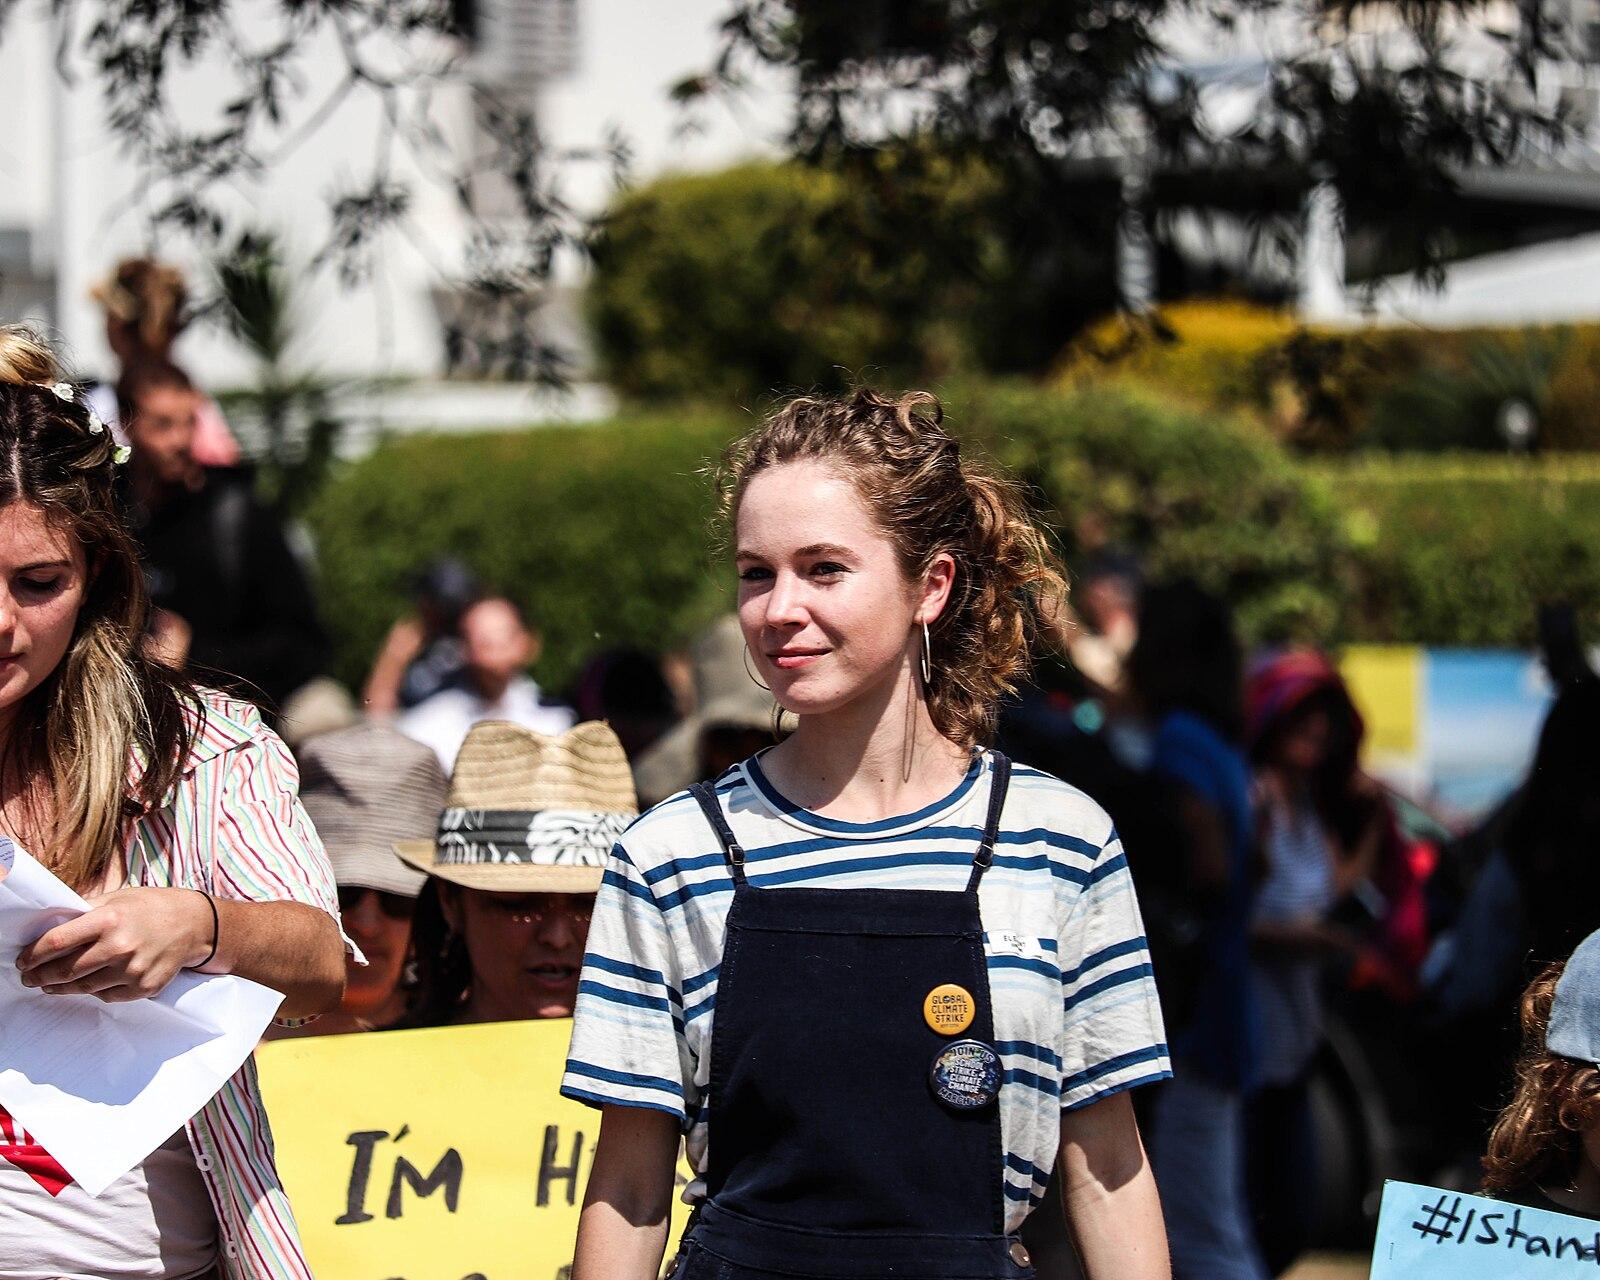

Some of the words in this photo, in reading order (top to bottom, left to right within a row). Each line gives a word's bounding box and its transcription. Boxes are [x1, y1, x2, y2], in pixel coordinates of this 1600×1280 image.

[932, 995, 966, 1004] GLOBAL
[932, 1004, 967, 1014] CLIMATE
[936, 1014, 964, 1023] STRIKE
[951, 1047, 976, 1056] JOIN
[980, 1050, 995, 1063] US
[955, 1058, 984, 1071] SCHOOL
[949, 1065, 977, 1077] STRIKE
[978, 1070, 986, 1079] 4
[949, 1073, 982, 1087] CLIMATE
[948, 1081, 981, 1094] CHANGE
[937, 1087, 970, 1105] MARCH
[334, 1124, 463, 1225] I'M
